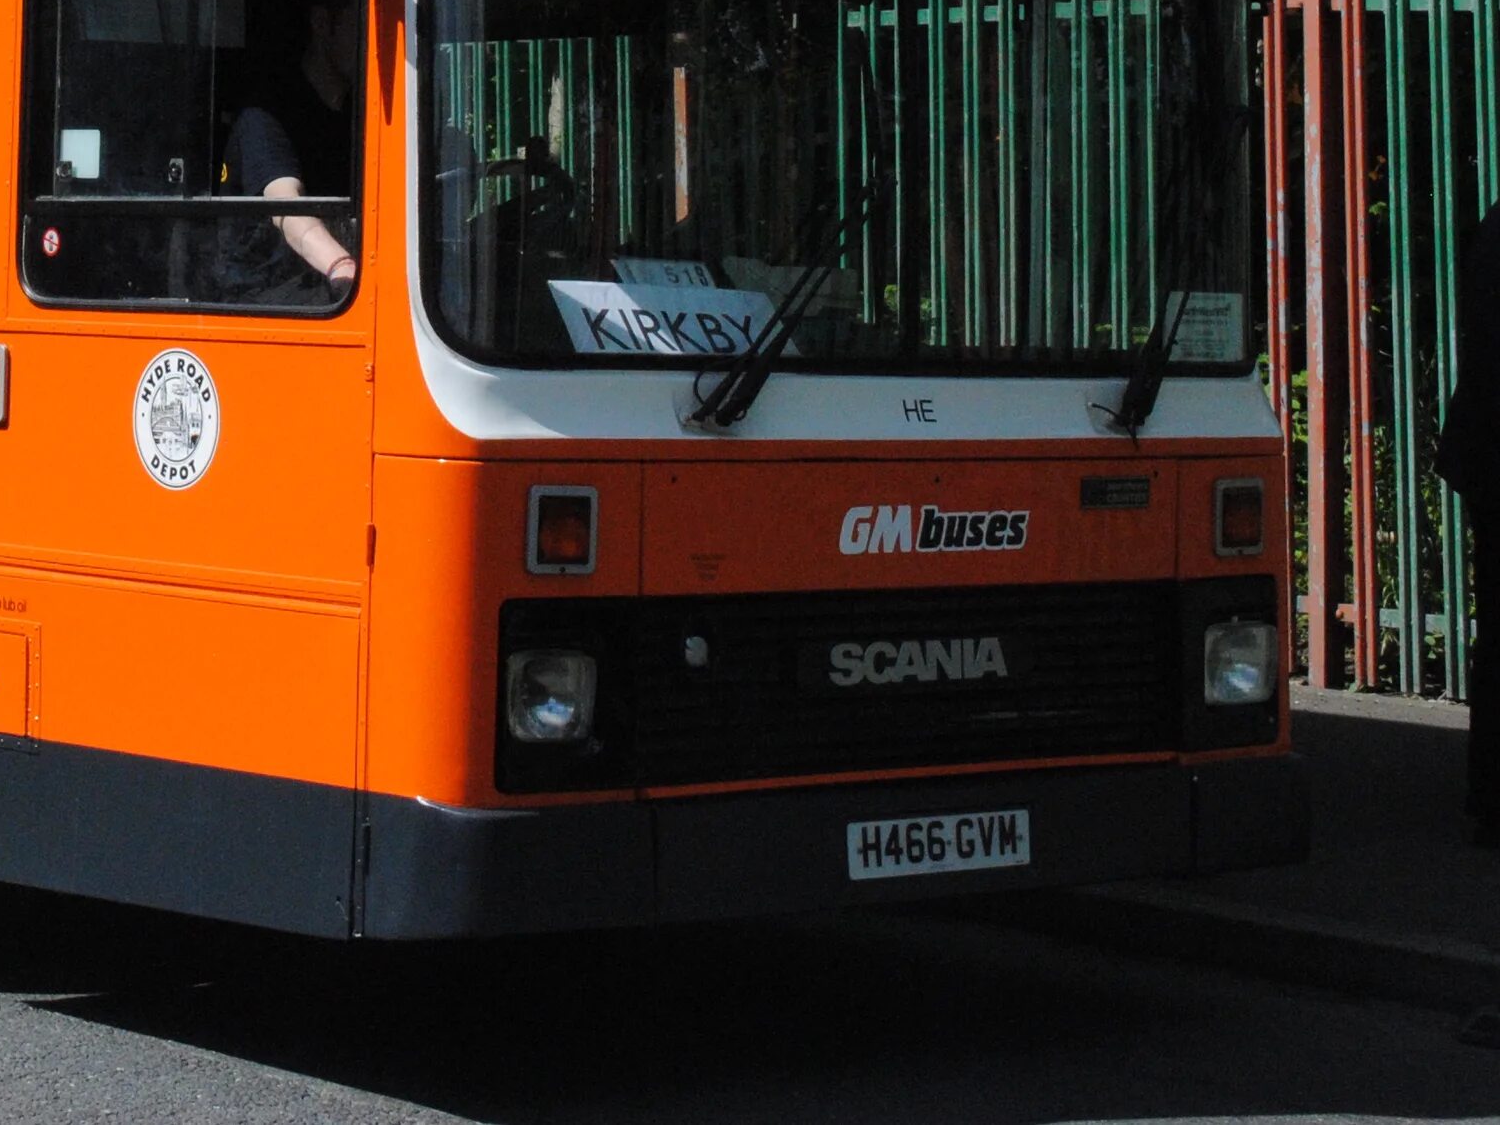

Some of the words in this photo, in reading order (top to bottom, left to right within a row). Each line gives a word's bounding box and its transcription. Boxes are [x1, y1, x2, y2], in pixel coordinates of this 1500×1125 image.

[581, 307, 758, 354] KIRKBY
[141, 359, 172, 403] HYDE
[176, 358, 212, 403] ROAD
[902, 399, 938, 423] HE
[150, 454, 197, 480] DEPOT
[838, 504, 912, 555] GM
[915, 504, 1030, 553] buses
[828, 637, 1008, 686] SCANIA
[860, 821, 947, 868] H466
[955, 813, 1018, 860] GVM
